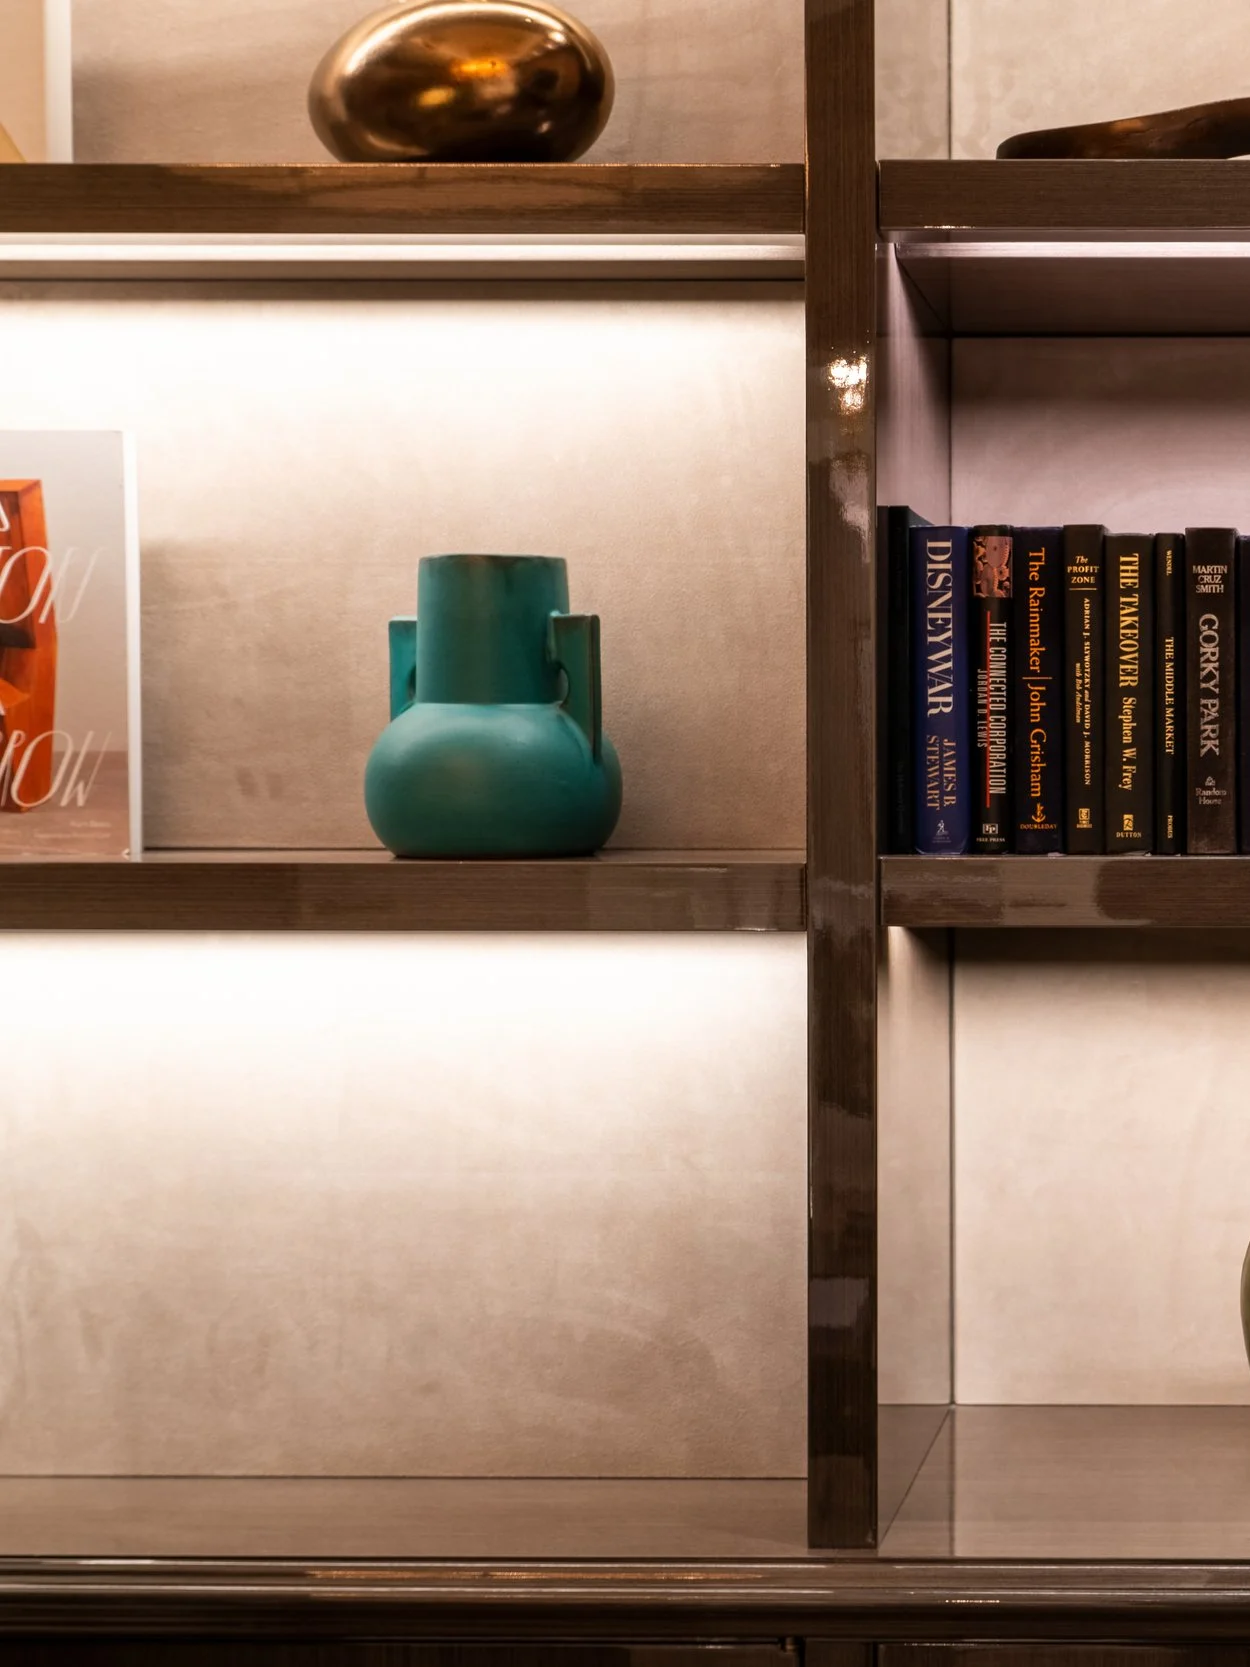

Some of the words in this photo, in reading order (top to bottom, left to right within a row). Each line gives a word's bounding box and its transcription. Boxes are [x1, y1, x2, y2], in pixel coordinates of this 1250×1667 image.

[1028, 548, 1045, 581] The
[1120, 553, 1139, 589] THE
[1192, 565, 1228, 574] MARTIN
[1197, 575, 1223, 584] CRUZ
[1195, 584, 1225, 594] SMITH
[926, 539, 953, 717] DISNEYWAR
[989, 622, 1006, 644] THE
[1028, 587, 1045, 673] Rainmaker
[1119, 594, 1139, 687] TAKEOVER
[1165, 637, 1174, 659] THE
[1200, 613, 1219, 692] GORKY
[977, 669, 987, 705] JORDAN
[989, 647, 1006, 710] CONNECTED
[1083, 690, 1091, 703] and
[1165, 662, 1174, 704] MIDDLE
[1028, 683, 1046, 723] John
[1119, 697, 1137, 743] Stephen
[977, 721, 987, 748] LEWIS
[1165, 708, 1174, 755] MARKET
[1200, 699, 1219, 757] PARK
[0, 730, 112, 807] ROW
[926, 735, 940, 810] STEWART
[942, 739, 956, 792] JAMES
[989, 715, 1006, 794] CORPORATION
[1030, 729, 1046, 797] Grisham
[1122, 748, 1136, 762] W.
[1118, 765, 1137, 790] Frey
[1195, 788, 1227, 796] Random
[1199, 797, 1222, 805] House
